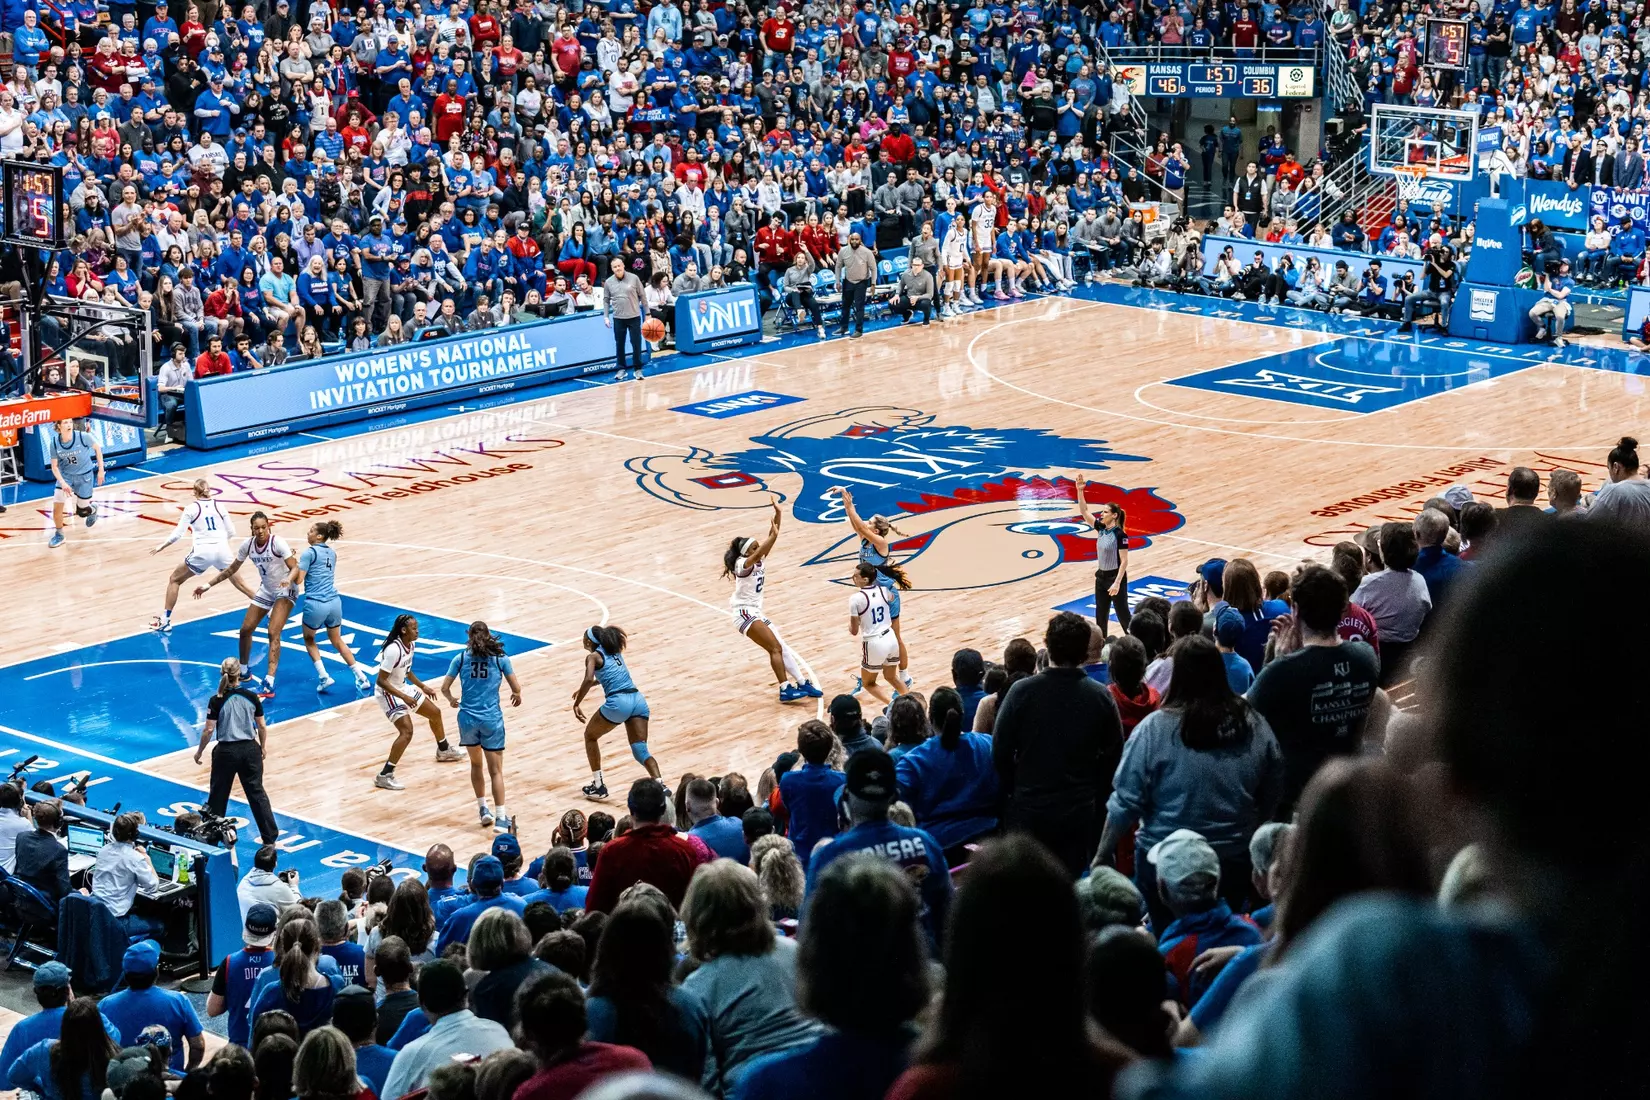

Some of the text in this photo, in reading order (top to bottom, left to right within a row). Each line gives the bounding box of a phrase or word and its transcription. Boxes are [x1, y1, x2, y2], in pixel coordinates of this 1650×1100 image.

[1441, 25, 1464, 38] 1:57
[1447, 39, 1459, 62] 5
[1150, 65, 1182, 75] KANSAS
[1206, 67, 1233, 82] 1:57
[1243, 66, 1275, 76] COLUMBIA
[1158, 78, 1177, 93] 46
[1195, 84, 1223, 95] PERIOD 3
[1252, 79, 1270, 93] 36
[1530, 193, 1583, 218] Wendy's
[1611, 190, 1649, 206] WNIT
[33, 197, 49, 236] 5
[983, 219, 994, 230] 33
[690, 299, 754, 335] WNIT
[334, 332, 531, 383] WOMEN'S NATIONAL
[309, 347, 558, 410] INVITATION TOURNAMENT
[0, 408, 51, 428] tateFarm
[66, 456, 78, 465] 12
[343, 463, 534, 506] Fieldhouse
[1310, 456, 1507, 519] Allen Fieldhouse
[204, 516, 217, 531] 11
[258, 564, 267, 576] 1
[871, 606, 885, 625] 13
[470, 661, 489, 679] 35
[1334, 660, 1350, 677] KU
[1313, 698, 1351, 711] KANSAS
[1311, 707, 1369, 724] CHAMPION
[860, 836, 927, 861] ANSAS
[249, 956, 262, 964] KU
[244, 967, 265, 980] DIC
[340, 964, 359, 977] ALK
